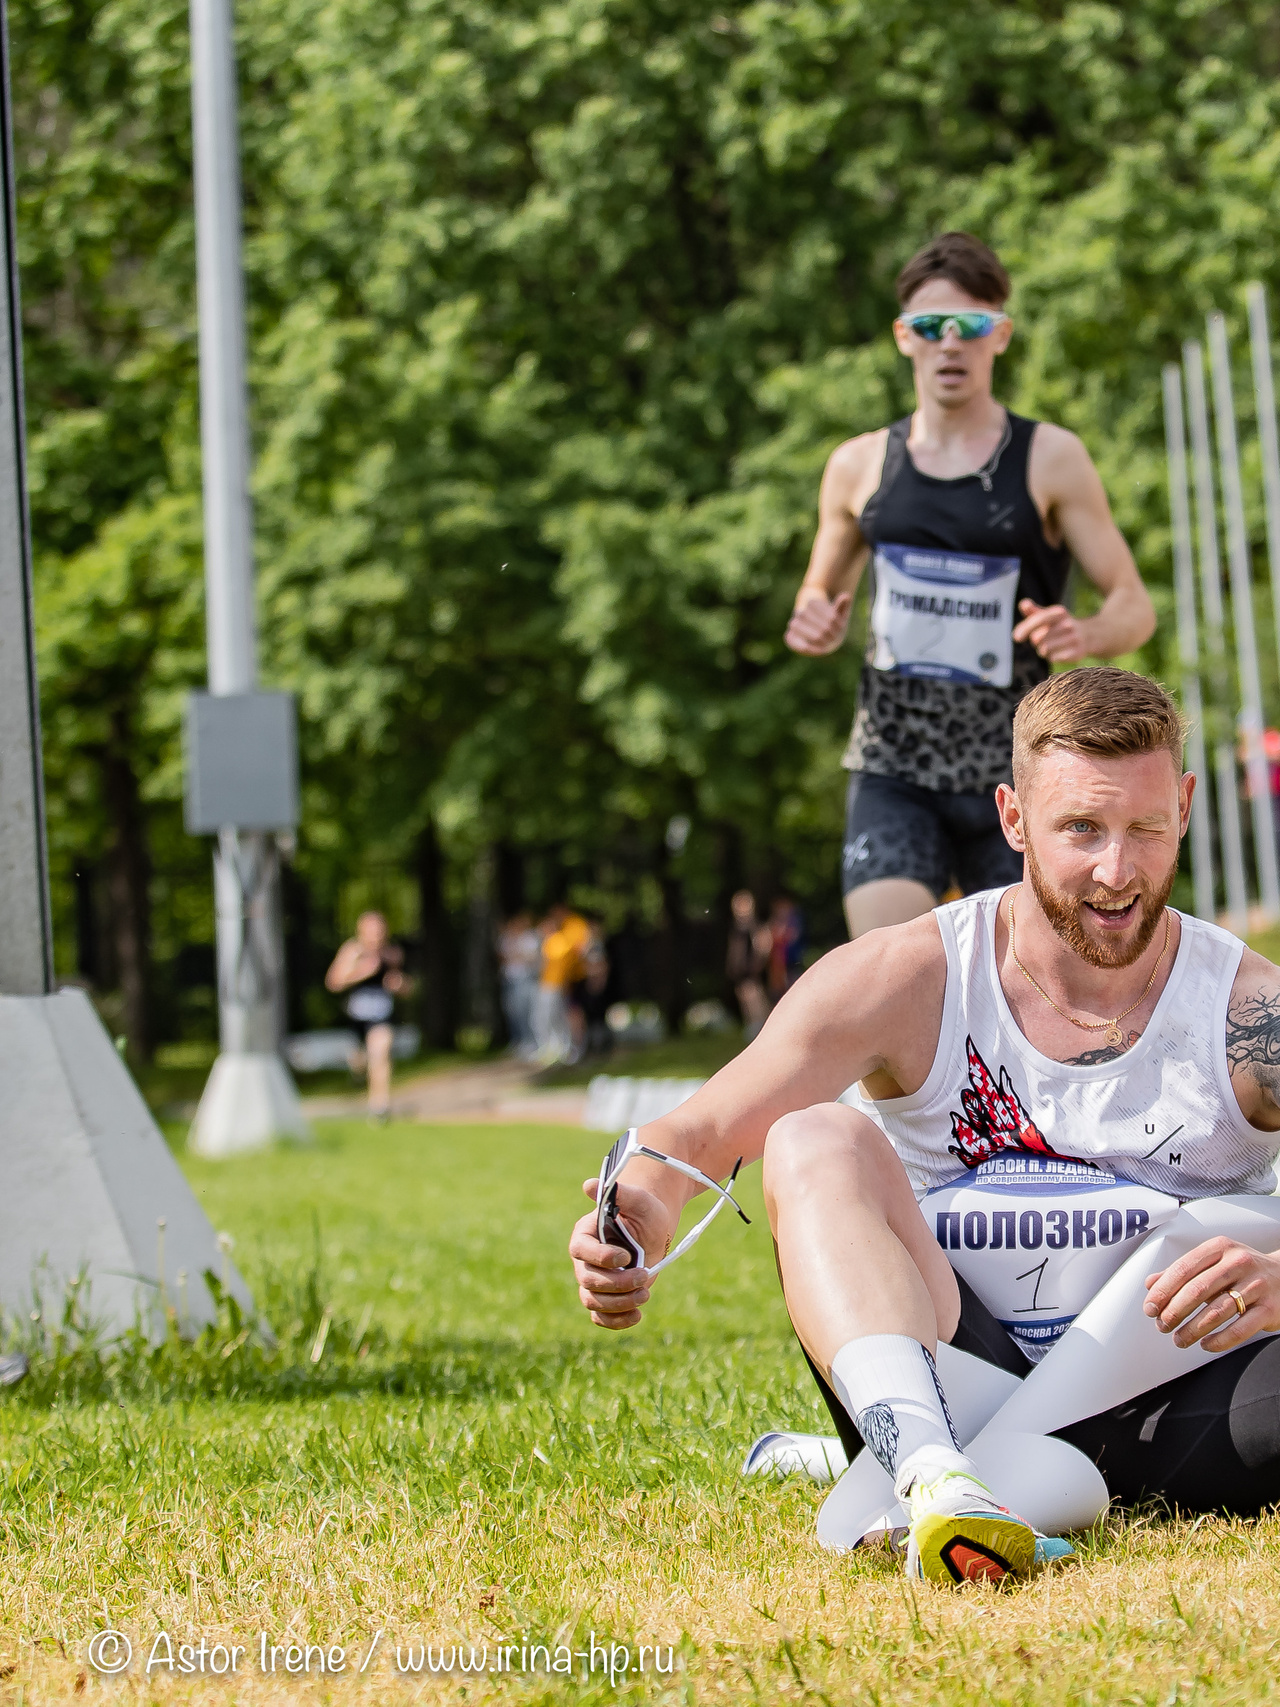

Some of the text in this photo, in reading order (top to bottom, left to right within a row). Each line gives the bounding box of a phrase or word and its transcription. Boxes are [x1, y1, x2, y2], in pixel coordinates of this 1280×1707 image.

[977, 1158, 1027, 1176] КУБОК
[1029, 1159, 1043, 1174] П.
[936, 1208, 1150, 1251] ПОЛОЗКОВ
[1012, 1257, 1060, 1314] 1
[1014, 1322, 1071, 1339] МОСКВА 202
